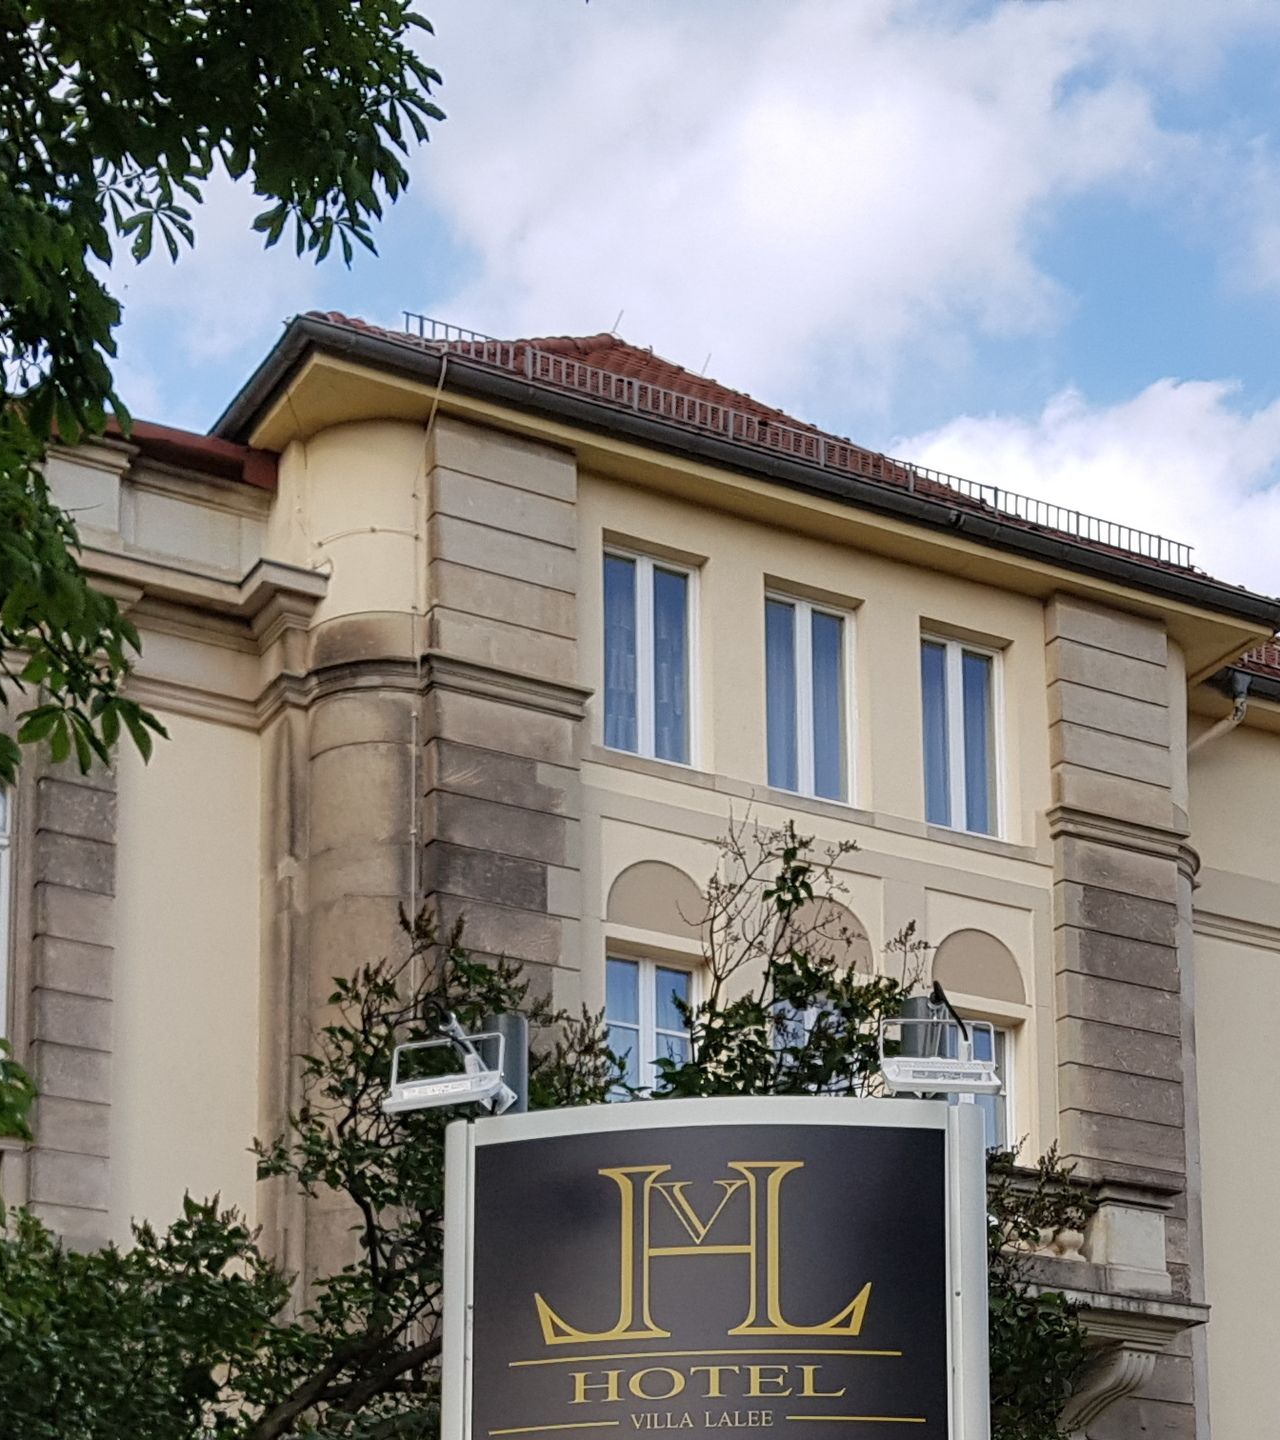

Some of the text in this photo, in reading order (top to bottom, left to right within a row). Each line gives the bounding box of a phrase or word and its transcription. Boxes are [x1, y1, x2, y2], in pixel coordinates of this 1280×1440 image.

[568, 1364, 846, 1405] HOTEL
[631, 1410, 774, 1430] VILLA LALEE
